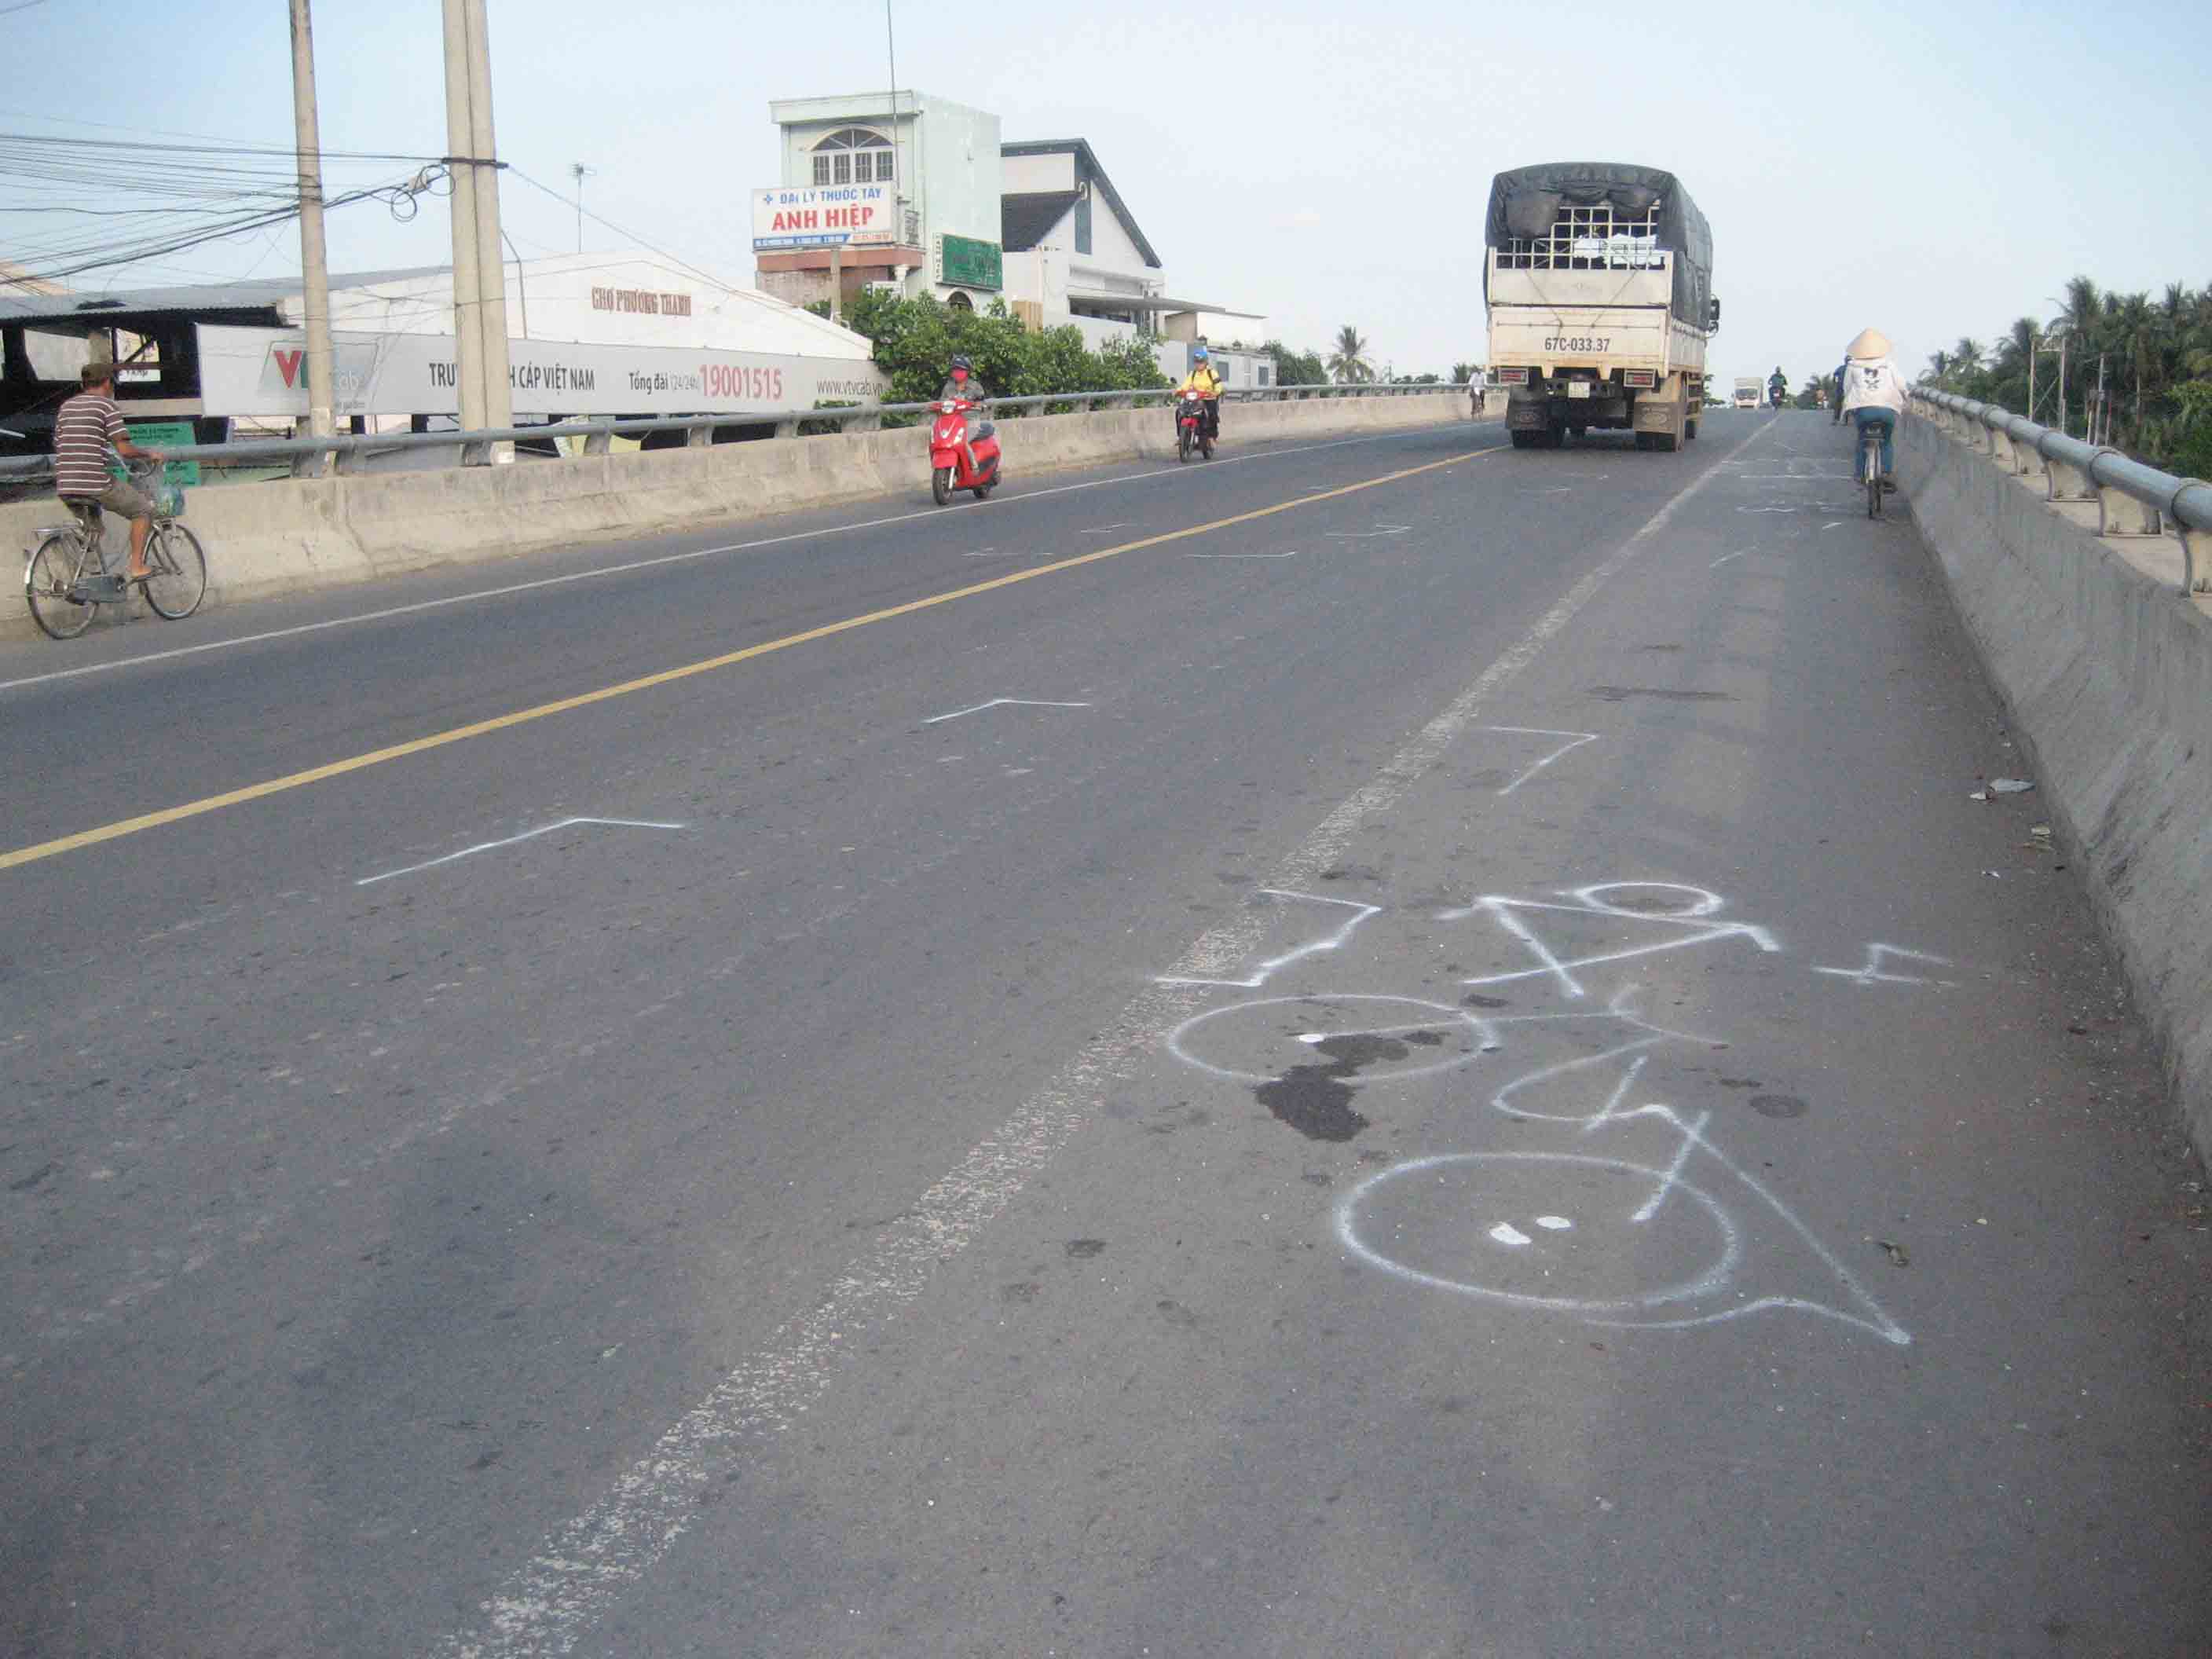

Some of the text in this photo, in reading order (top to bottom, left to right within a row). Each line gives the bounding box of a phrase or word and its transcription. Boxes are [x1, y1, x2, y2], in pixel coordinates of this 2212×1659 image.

[772, 203, 874, 231] ANH HIỆP
[1545, 338, 1610, 353] 67C-033.37
[543, 362, 567, 395] VIỆT
[569, 368, 595, 390] NAM
[699, 364, 782, 400] 19001515
